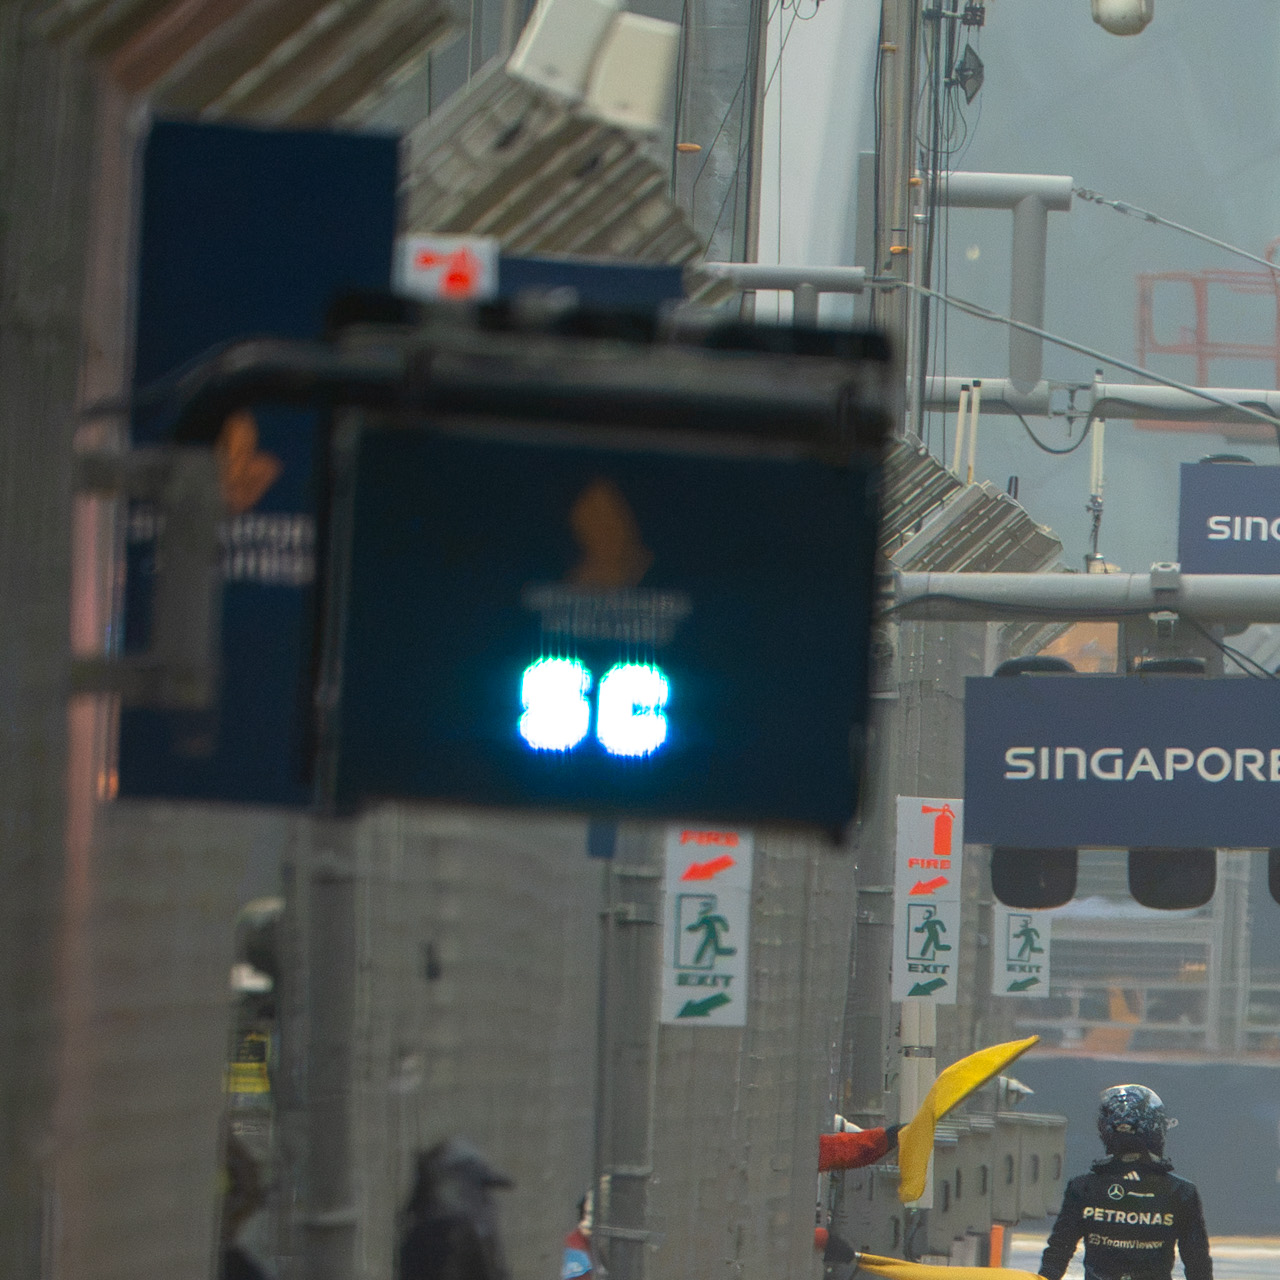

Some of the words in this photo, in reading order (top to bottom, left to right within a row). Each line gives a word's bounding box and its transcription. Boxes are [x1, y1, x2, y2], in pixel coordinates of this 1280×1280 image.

[518, 657, 670, 757] SC
[679, 830, 741, 848] FIRE
[908, 858, 952, 870] FIRE
[908, 963, 950, 975] EXIT
[1006, 964, 1043, 974] EXIT
[675, 973, 734, 988] EXIT
[1083, 1206, 1174, 1226] PETRONAS
